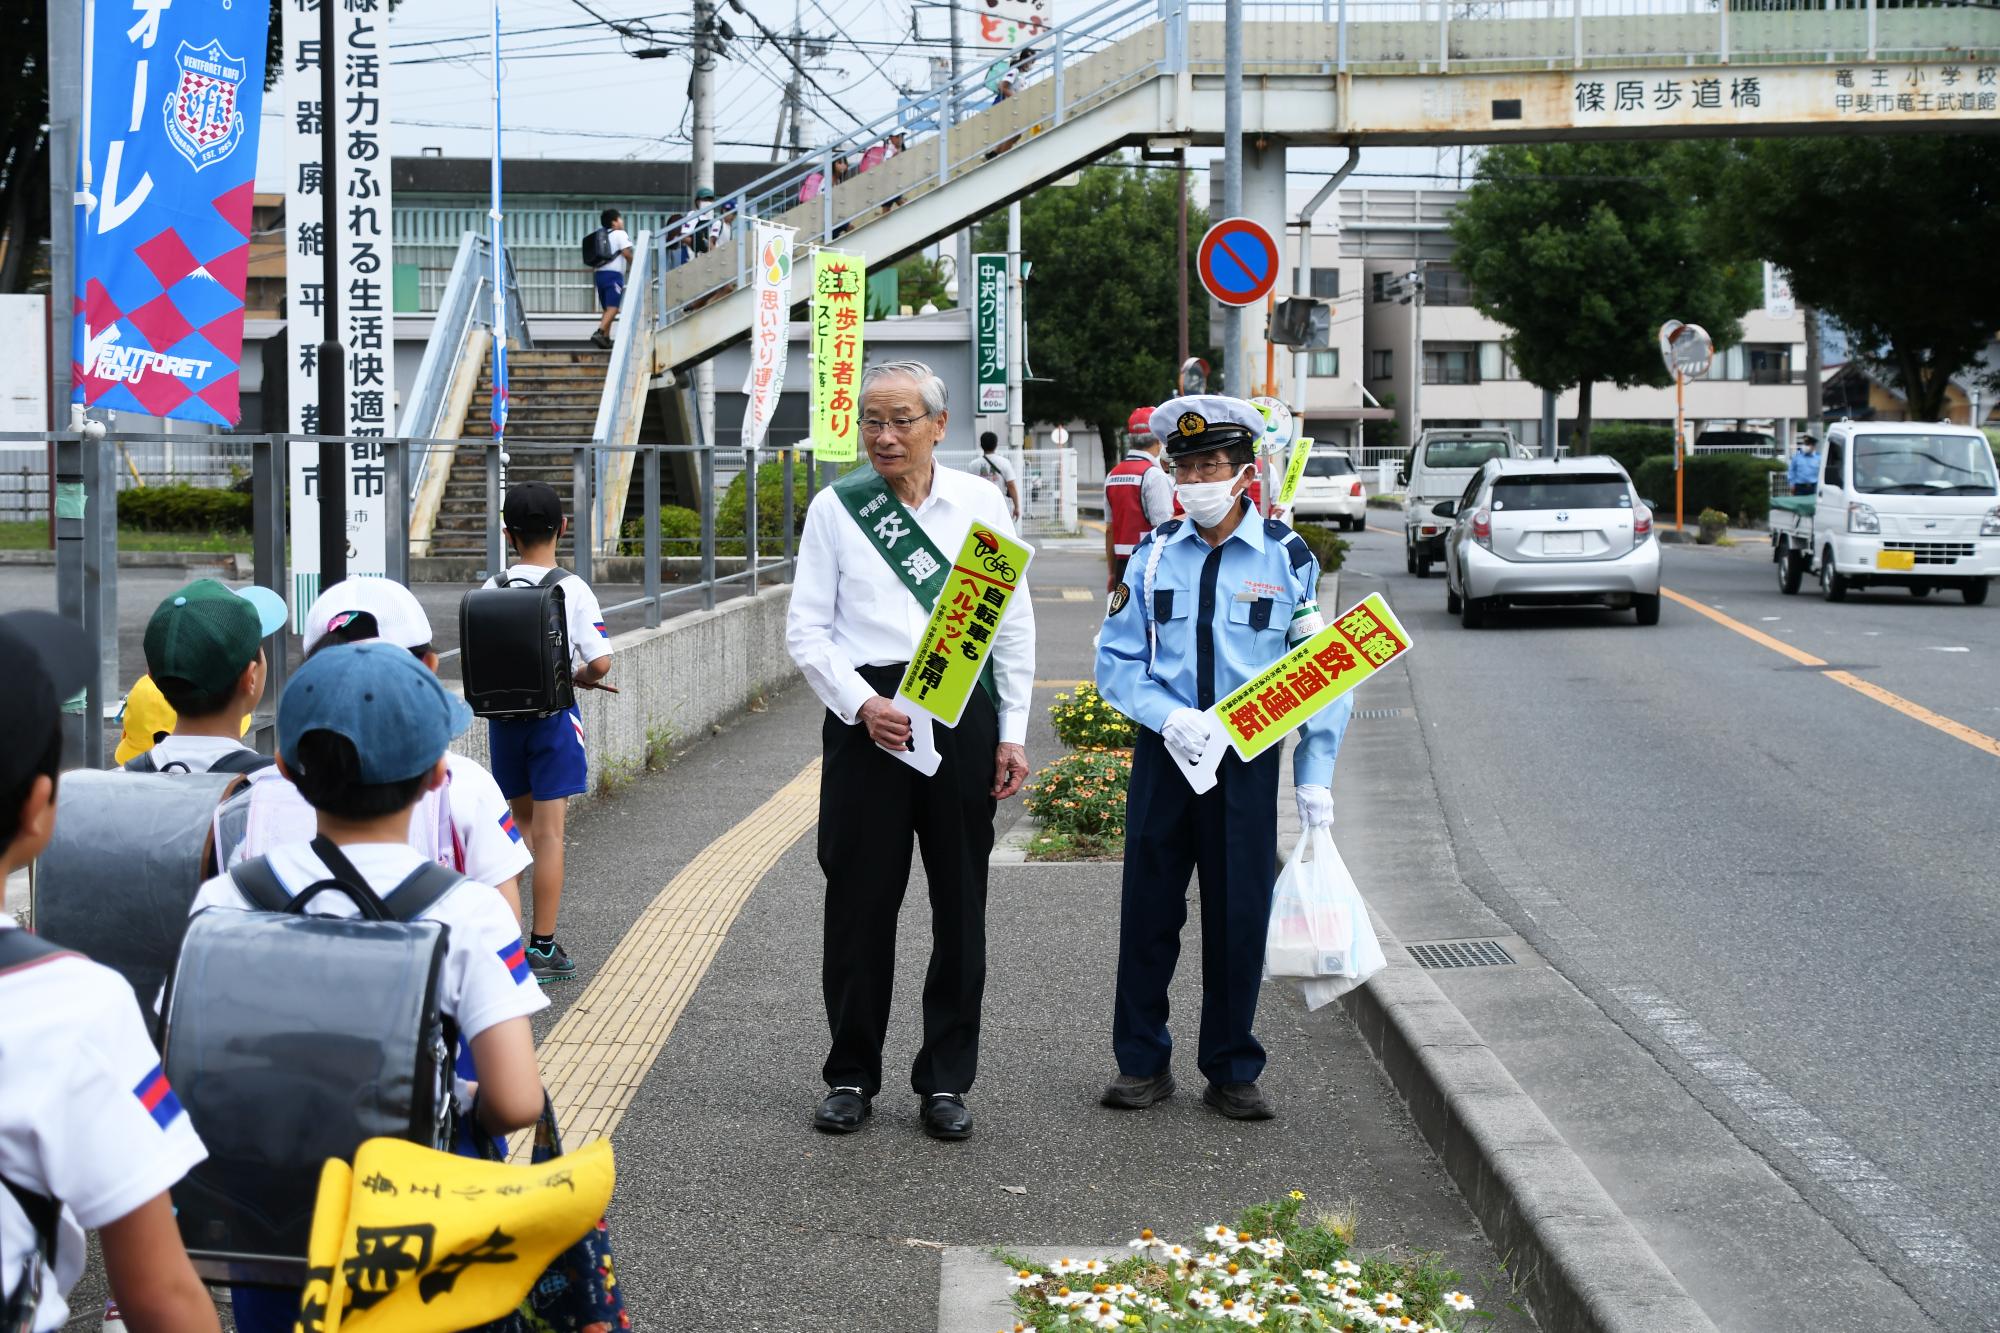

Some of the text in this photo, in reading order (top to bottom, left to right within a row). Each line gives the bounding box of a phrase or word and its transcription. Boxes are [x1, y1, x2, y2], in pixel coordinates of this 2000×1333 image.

[183, 55, 240, 81] VENTFORET KOFU
[1836, 65, 1997, 89] 竜王小学校
[1575, 77, 1761, 111] 篠原歩道橋
[1836, 92, 1997, 114] 甲斐市竜王武道館
[168, 118, 198, 159] YAMANASHI
[818, 269, 860, 295] 注意
[980, 263, 996, 379] 中沢クリニック
[83, 321, 213, 380] VENTFORET
[93, 360, 144, 384] KOFU
[829, 306, 858, 438] 歩行者あり
[859, 492, 888, 518] 甲斐市
[873, 510, 941, 596] 交通
[960, 585, 1006, 661] 自転車も
[1339, 608, 1398, 665] 根絶
[1228, 640, 1357, 741] 飲酒運転
